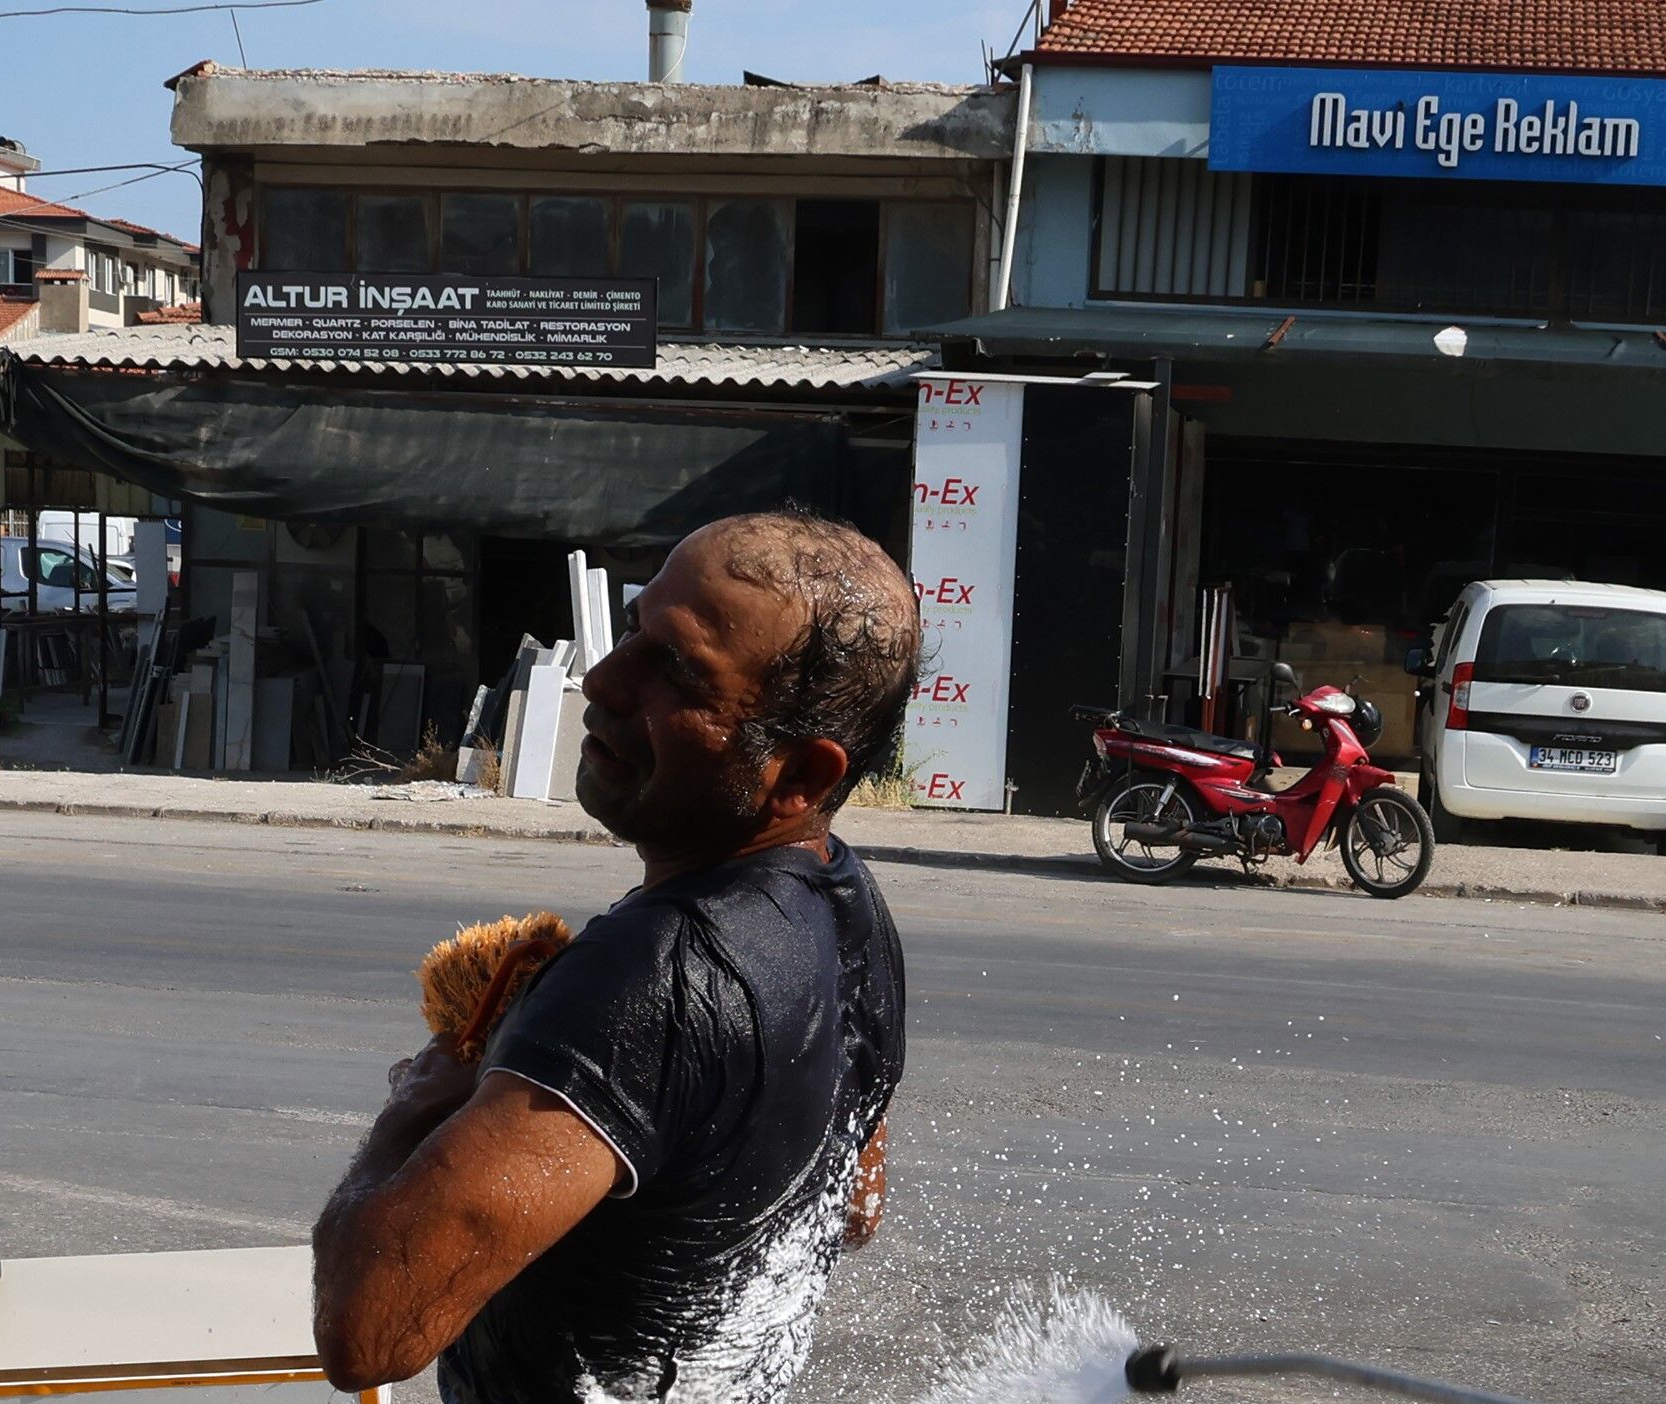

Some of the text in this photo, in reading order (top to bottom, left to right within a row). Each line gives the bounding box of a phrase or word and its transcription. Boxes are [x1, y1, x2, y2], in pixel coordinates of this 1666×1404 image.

[1309, 92, 1405, 148] Mavi
[1415, 95, 1485, 168] Ege
[1493, 97, 1640, 157] Reklam
[243, 280, 480, 316] ALTUR İNŞAAT
[529, 288, 564, 299] NAKLİYAT
[573, 289, 598, 300] DEMİR
[606, 290, 641, 301] ÇİMENTO
[486, 299, 641, 312] KARO SANAYİ VE TİCARET LİMİTED ŞİRKETİ
[250, 318, 631, 332] MERMER QUARTZ PORSELEN BİNA TADİLAT RESTORASYON
[272, 330, 607, 343] DEKORASYON KAT KARŞILIĞI MÜHENDİSLİK MİMARLIK
[270, 347, 613, 361] GSM: 0530 074 52 08 0533 772 86 72 0532 243 62 70
[1539, 748, 1613, 767] 34 MCD 523
[910, 773, 966, 800] -Ex
